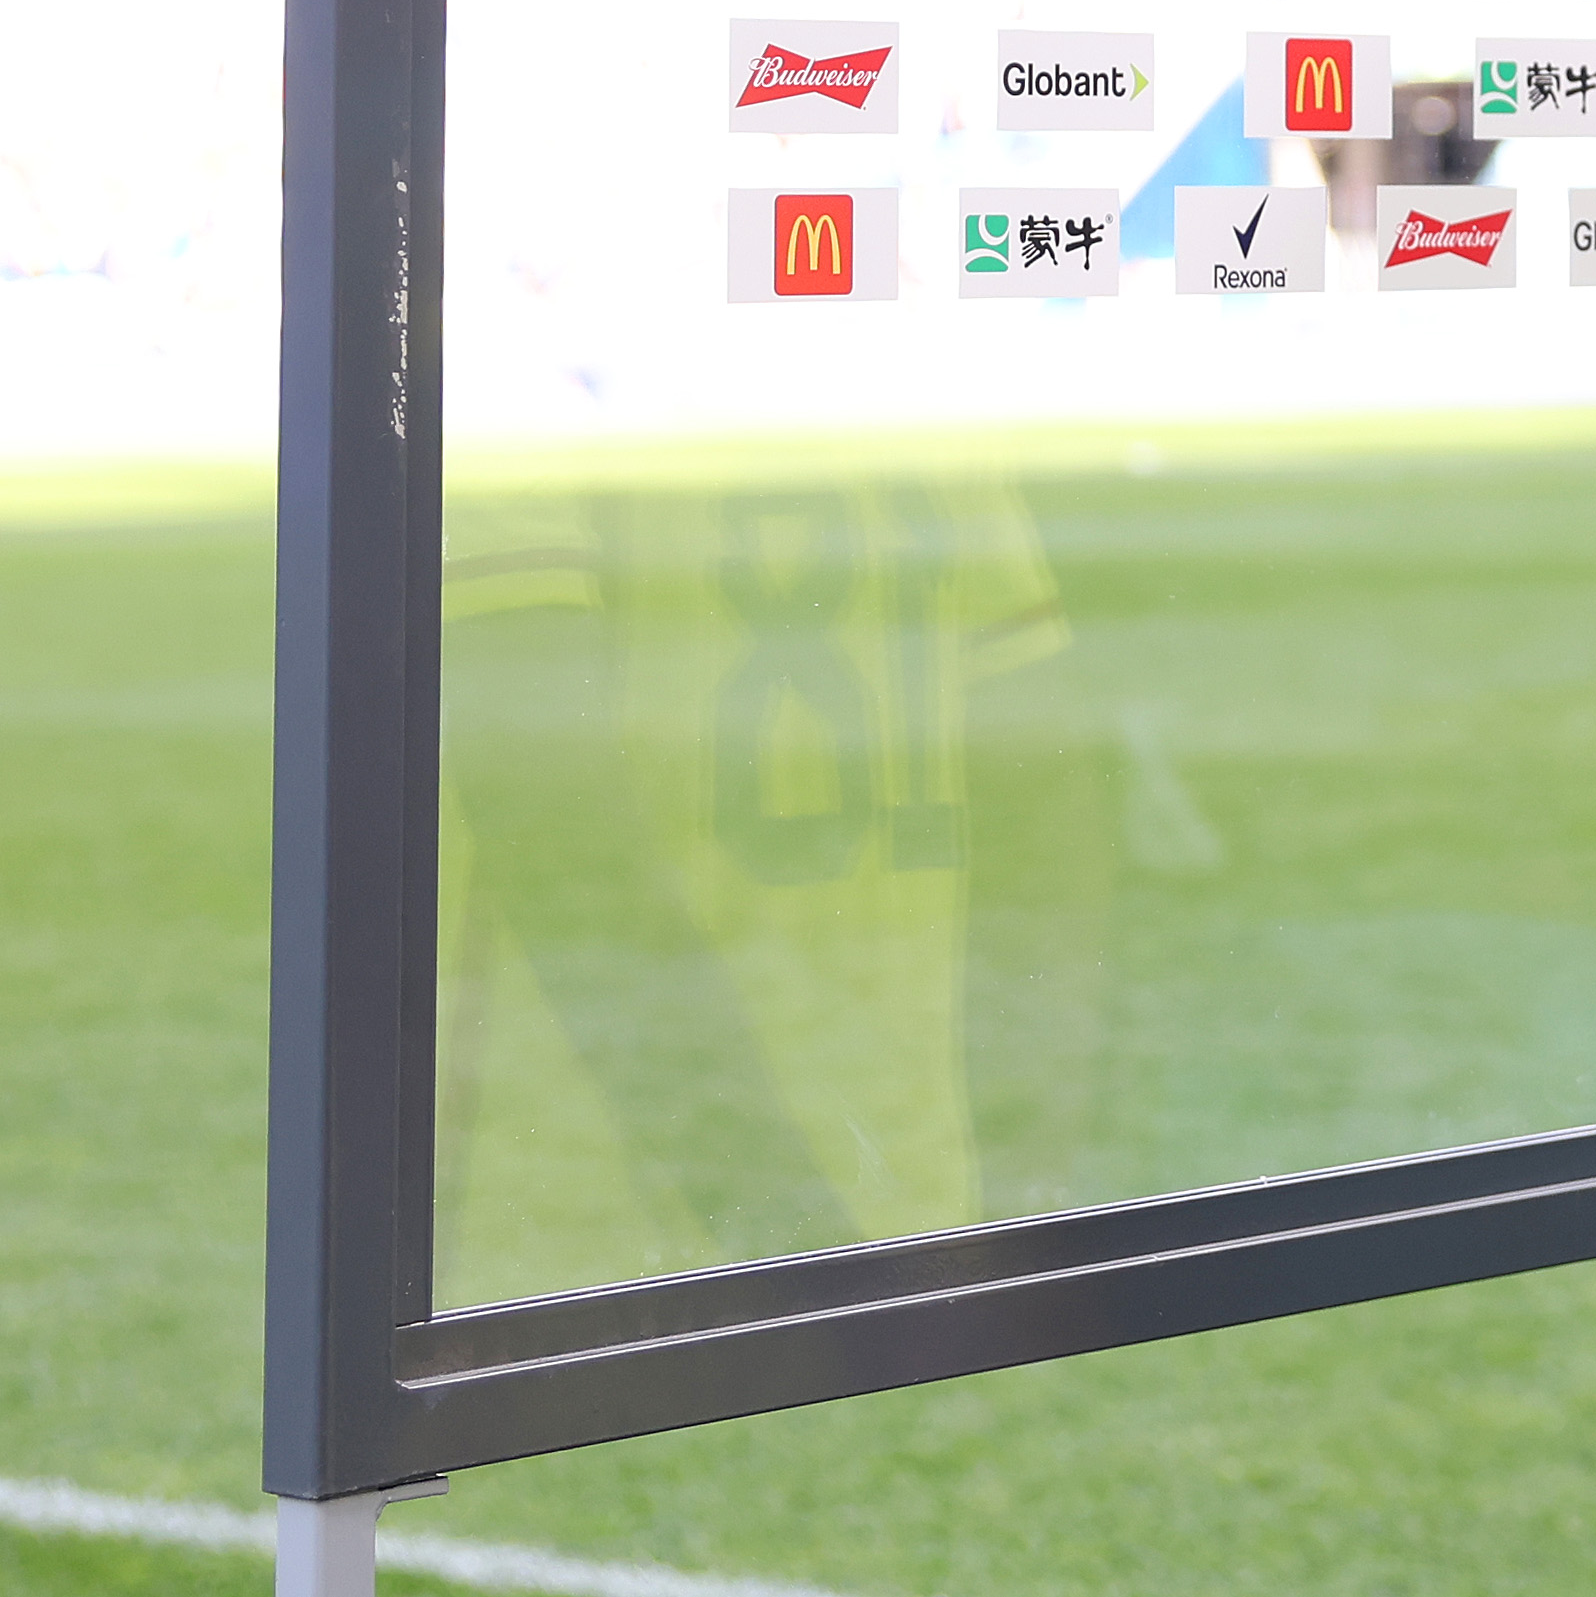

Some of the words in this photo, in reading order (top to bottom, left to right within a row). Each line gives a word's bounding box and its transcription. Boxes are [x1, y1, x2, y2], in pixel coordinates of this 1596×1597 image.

[749, 57, 880, 89] Budweiser
[1002, 63, 1127, 98] Globant
[1019, 214, 1105, 271] 蒙牛
[1396, 220, 1503, 251] Budweiser
[1214, 263, 1287, 289] Rexona
